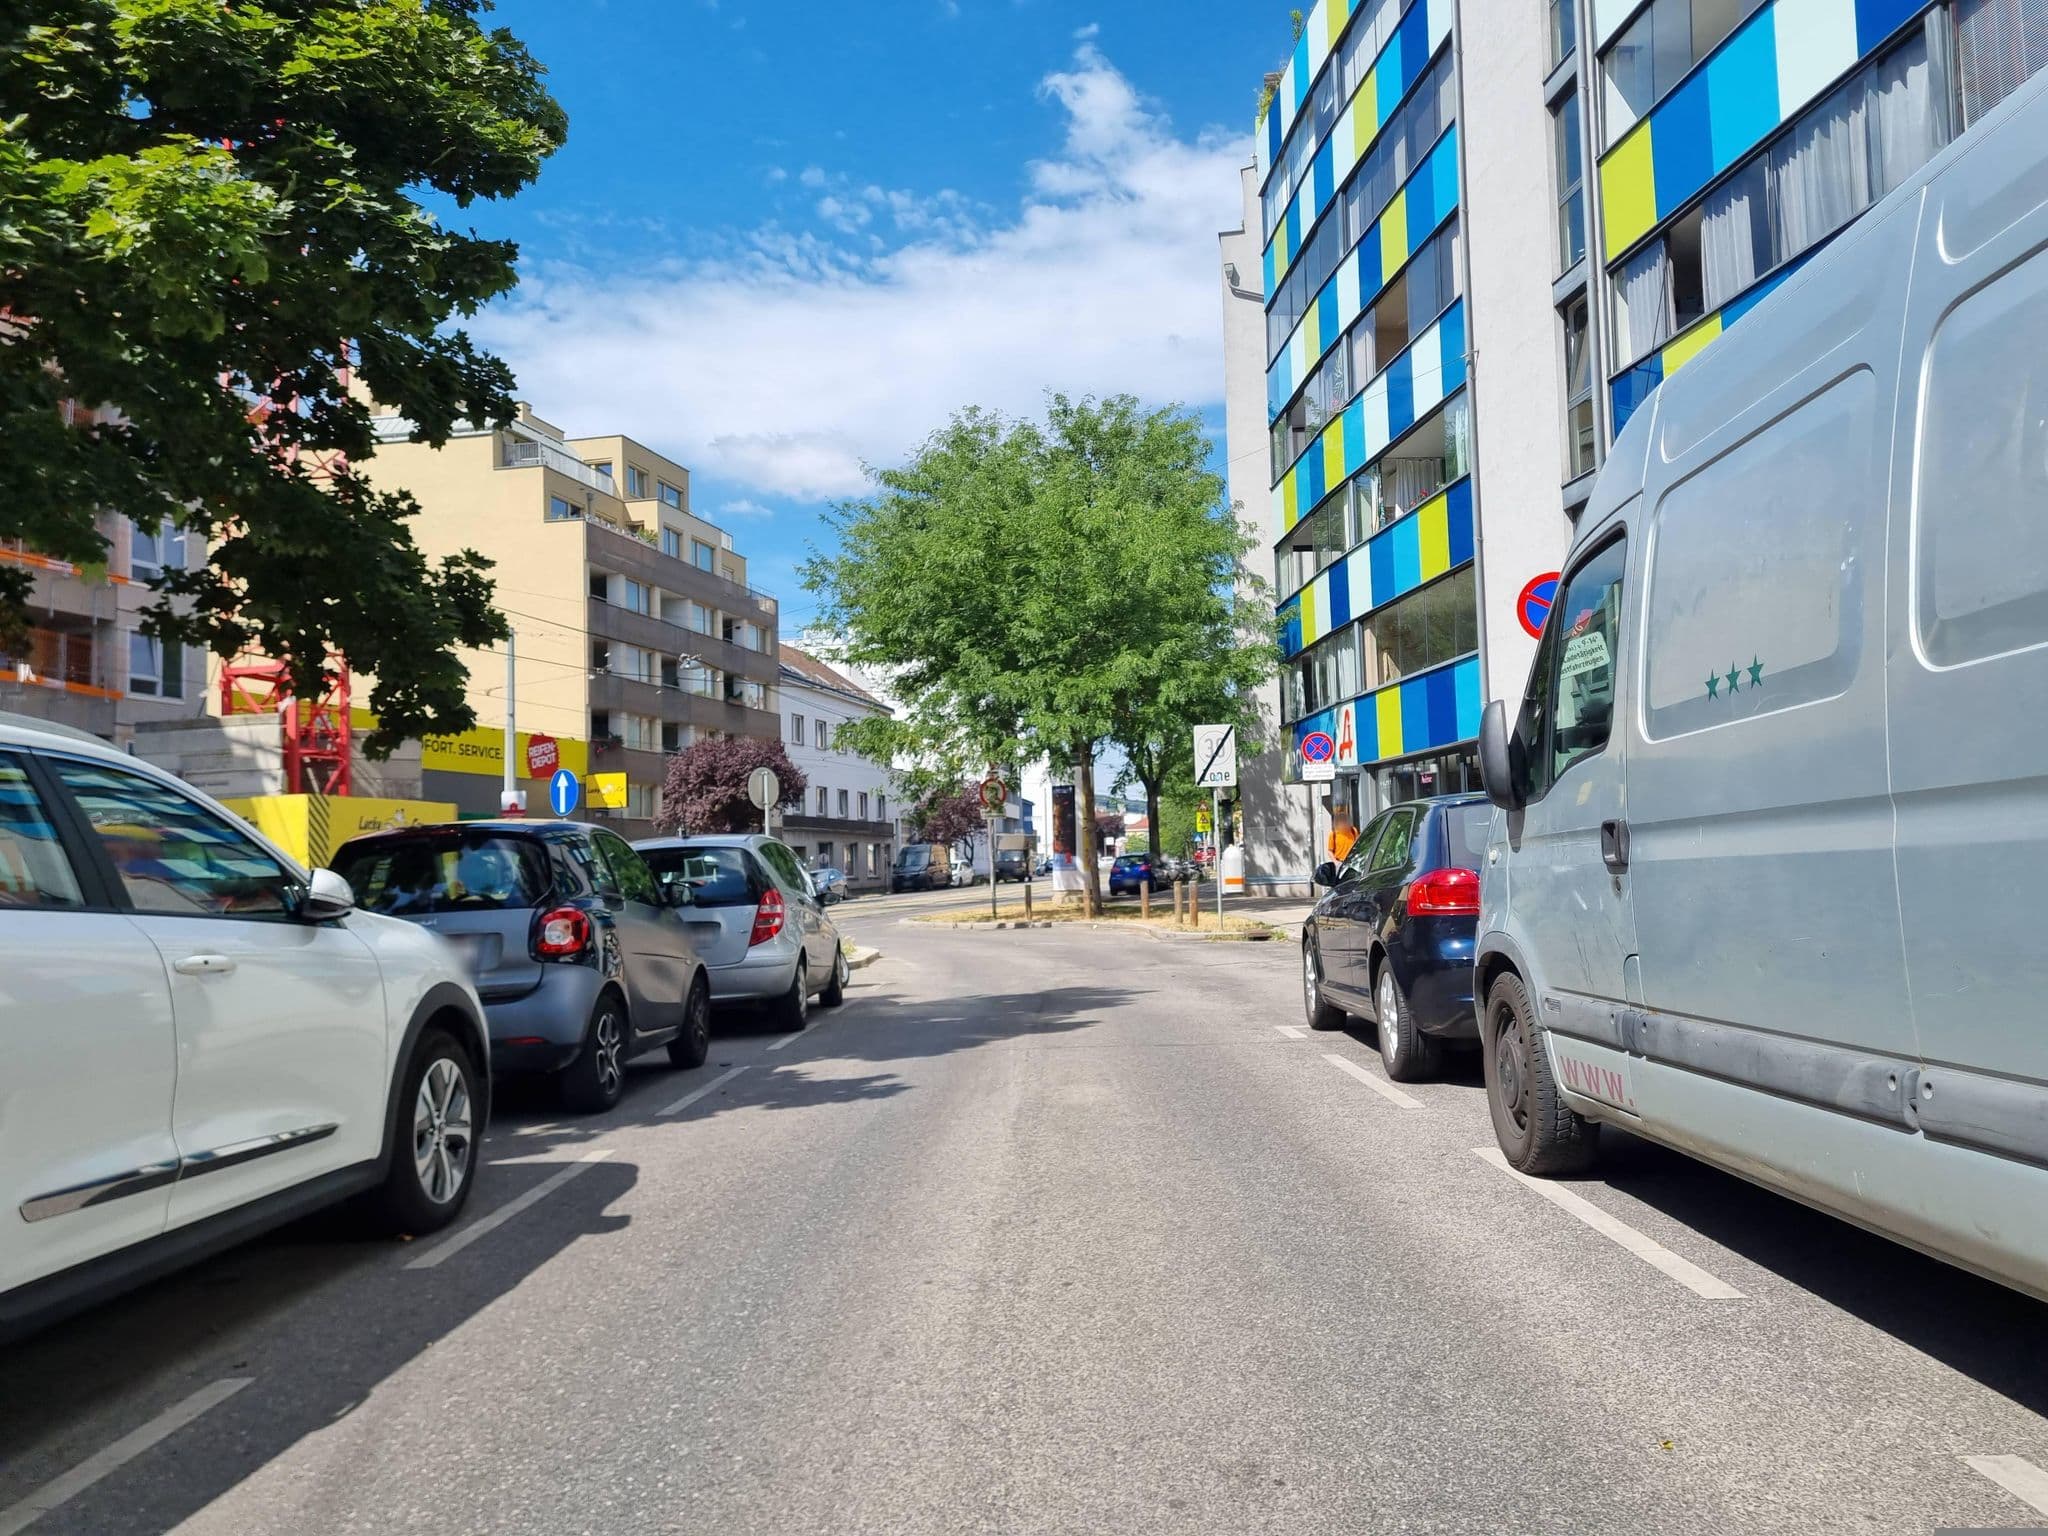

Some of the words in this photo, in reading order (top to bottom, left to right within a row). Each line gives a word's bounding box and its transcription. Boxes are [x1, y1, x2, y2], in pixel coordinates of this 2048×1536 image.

[422, 738, 457, 755] FORT.
[1204, 737, 1226, 758] 30
[531, 753, 557, 769] DEPOT
